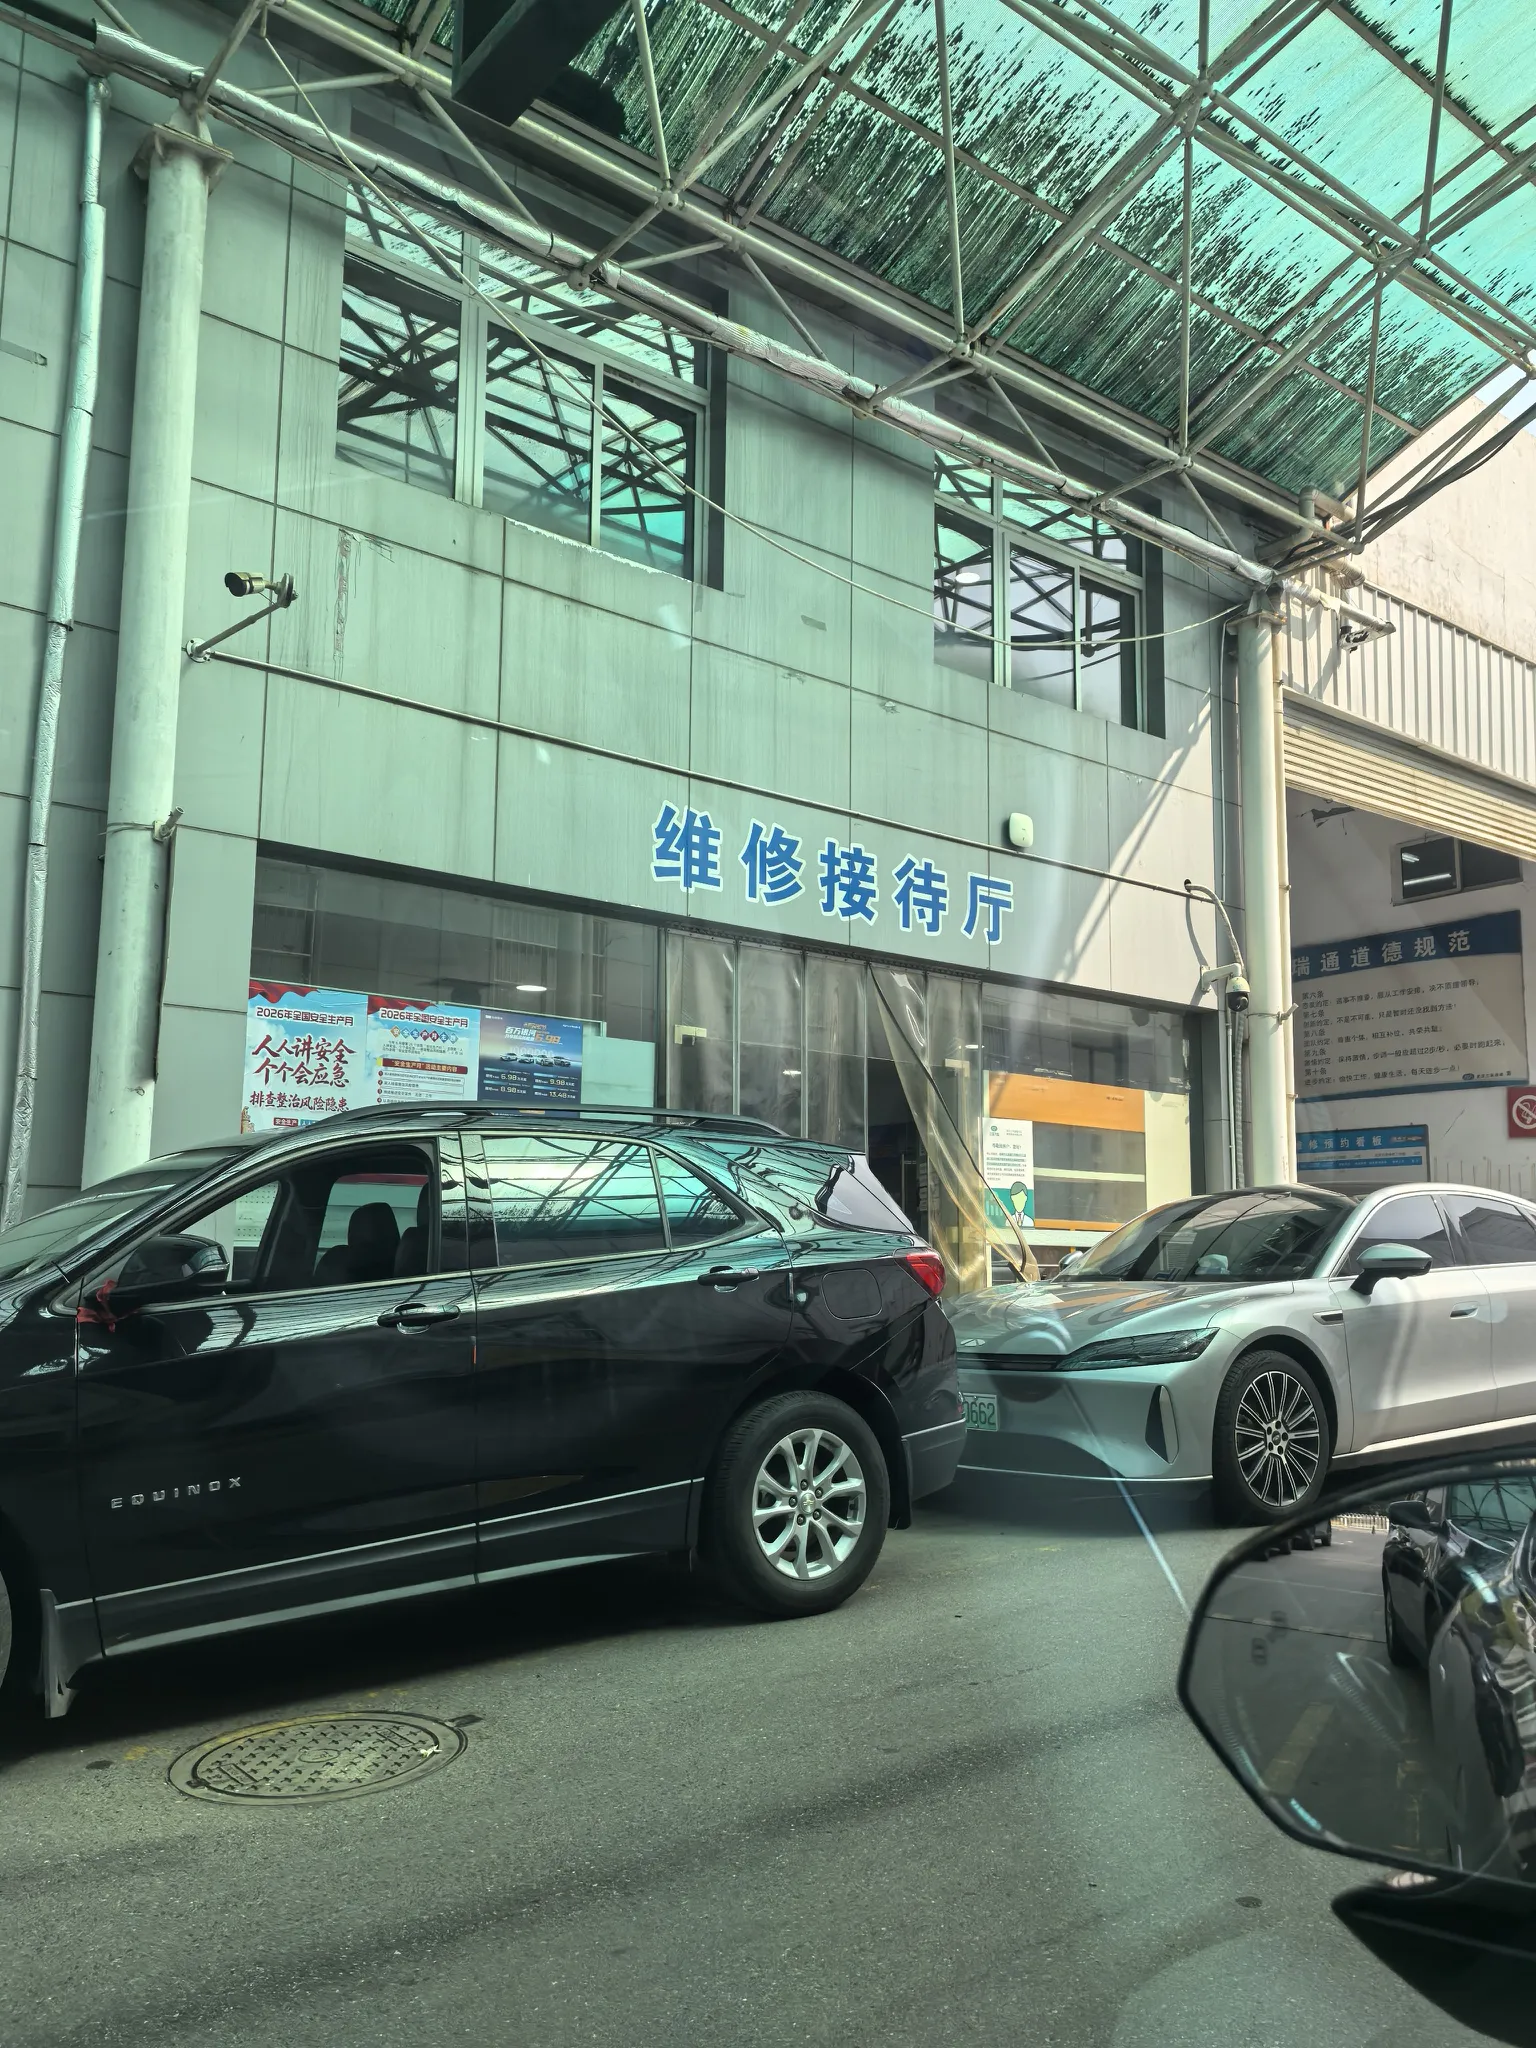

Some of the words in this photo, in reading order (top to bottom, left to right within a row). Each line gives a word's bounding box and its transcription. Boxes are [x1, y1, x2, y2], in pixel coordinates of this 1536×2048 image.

[651, 800, 1014, 944] 维修接待厅
[256, 1007, 354, 1026] 2026年全国安全生产月
[380, 1008, 468, 1028] 2026年全国安全生产月
[251, 1034, 355, 1064] 人人讲安全
[253, 1057, 350, 1088] 个个会应急
[249, 1091, 350, 1112] 排查整治风险隐患
[110, 1476, 242, 1509] EQUINOX
